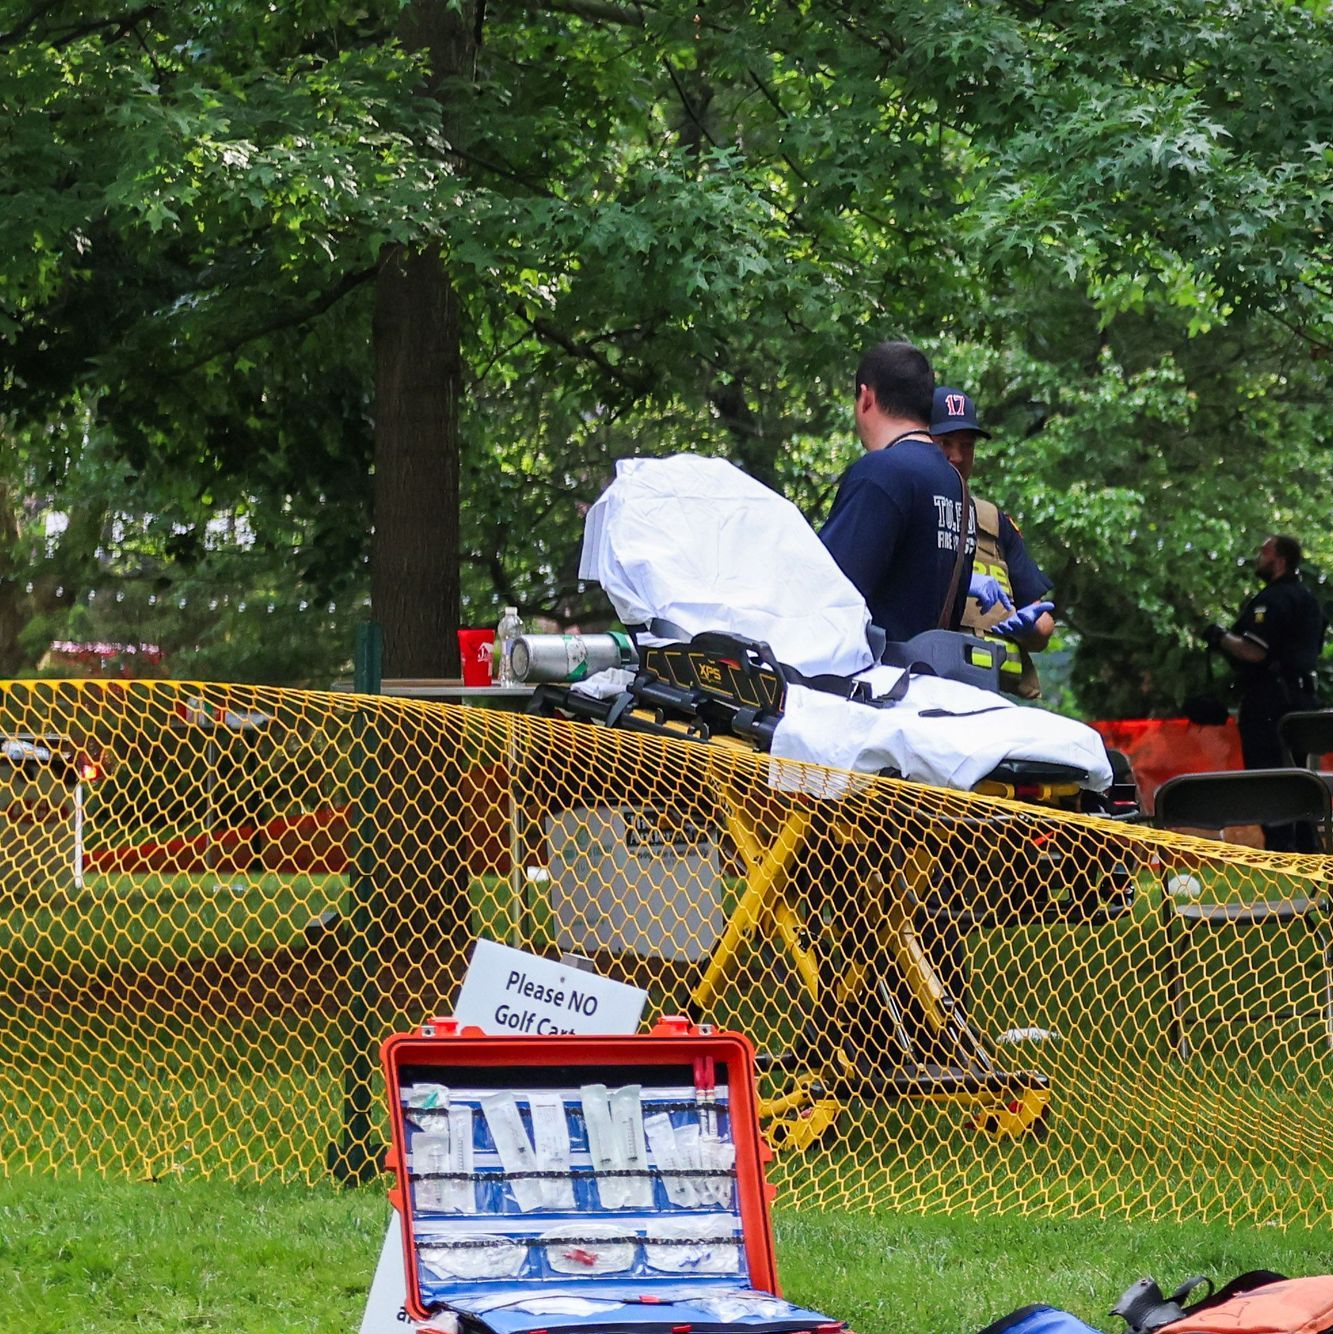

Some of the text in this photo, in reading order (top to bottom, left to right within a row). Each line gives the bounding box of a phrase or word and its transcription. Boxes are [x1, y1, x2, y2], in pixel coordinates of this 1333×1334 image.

[945, 394, 966, 416] 17
[506, 970, 599, 1017] Please NO
[495, 1004, 536, 1033] Golf
